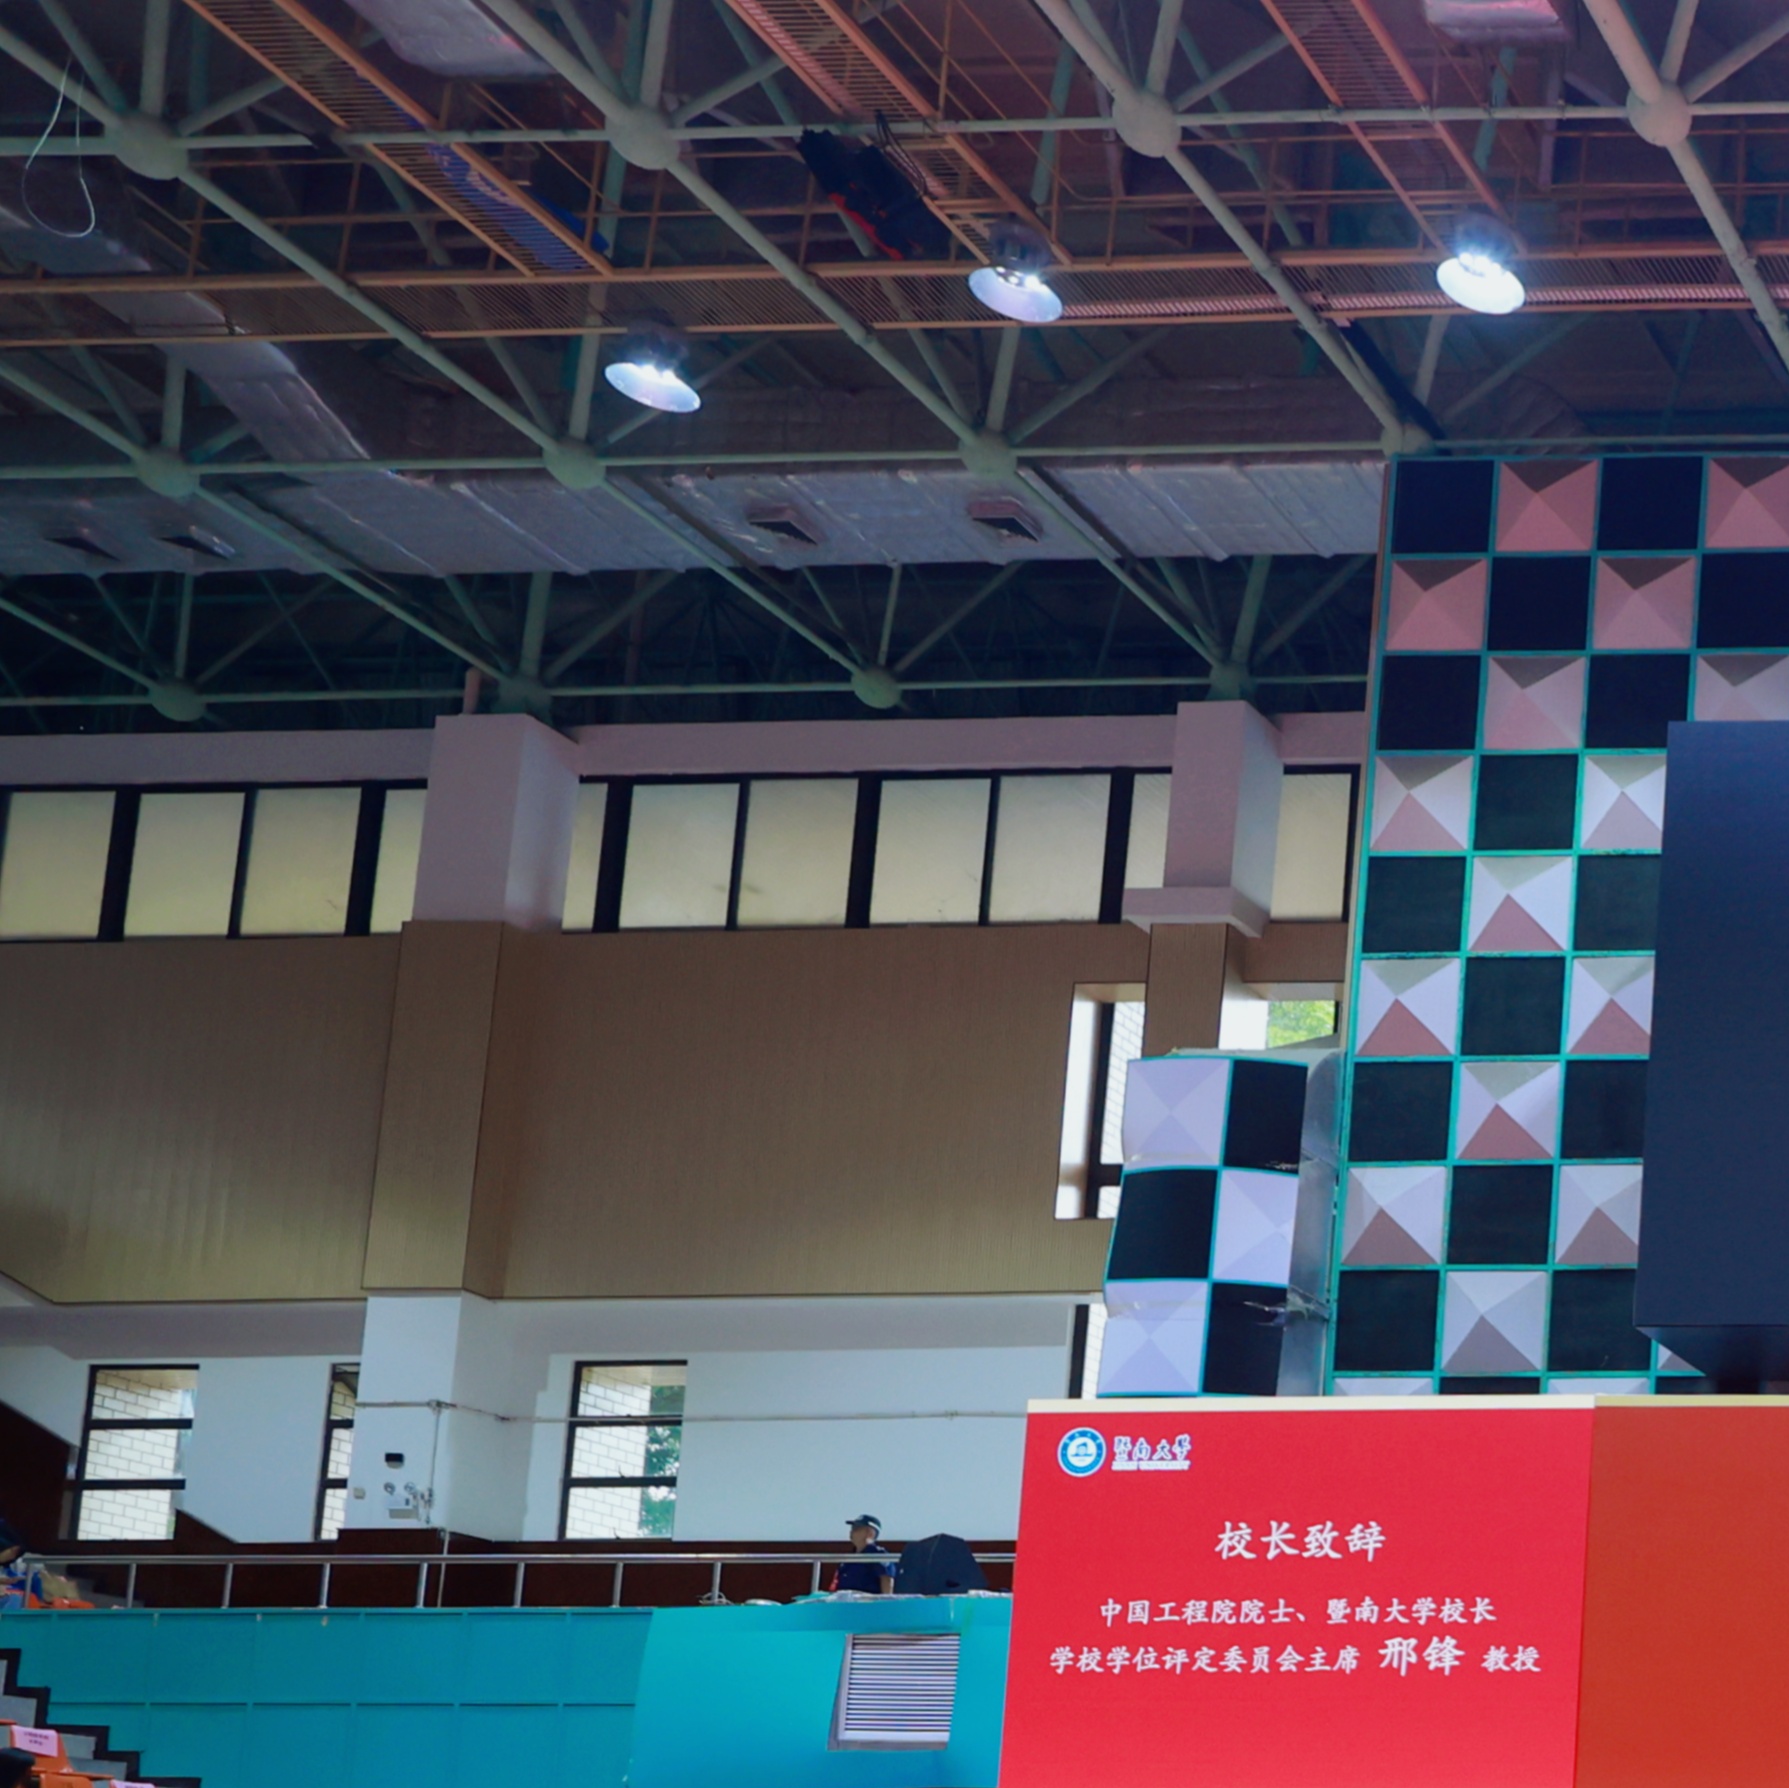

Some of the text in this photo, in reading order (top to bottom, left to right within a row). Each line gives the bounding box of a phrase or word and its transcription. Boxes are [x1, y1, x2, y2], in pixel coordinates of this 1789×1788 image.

[1214, 1520, 1386, 1562] 校长致辞
[1100, 1597, 1497, 1627] 中国工程院院士、暨南大学校长
[1050, 1635, 1541, 1677] 学校学位评定委员会主席 邢锋 教授
